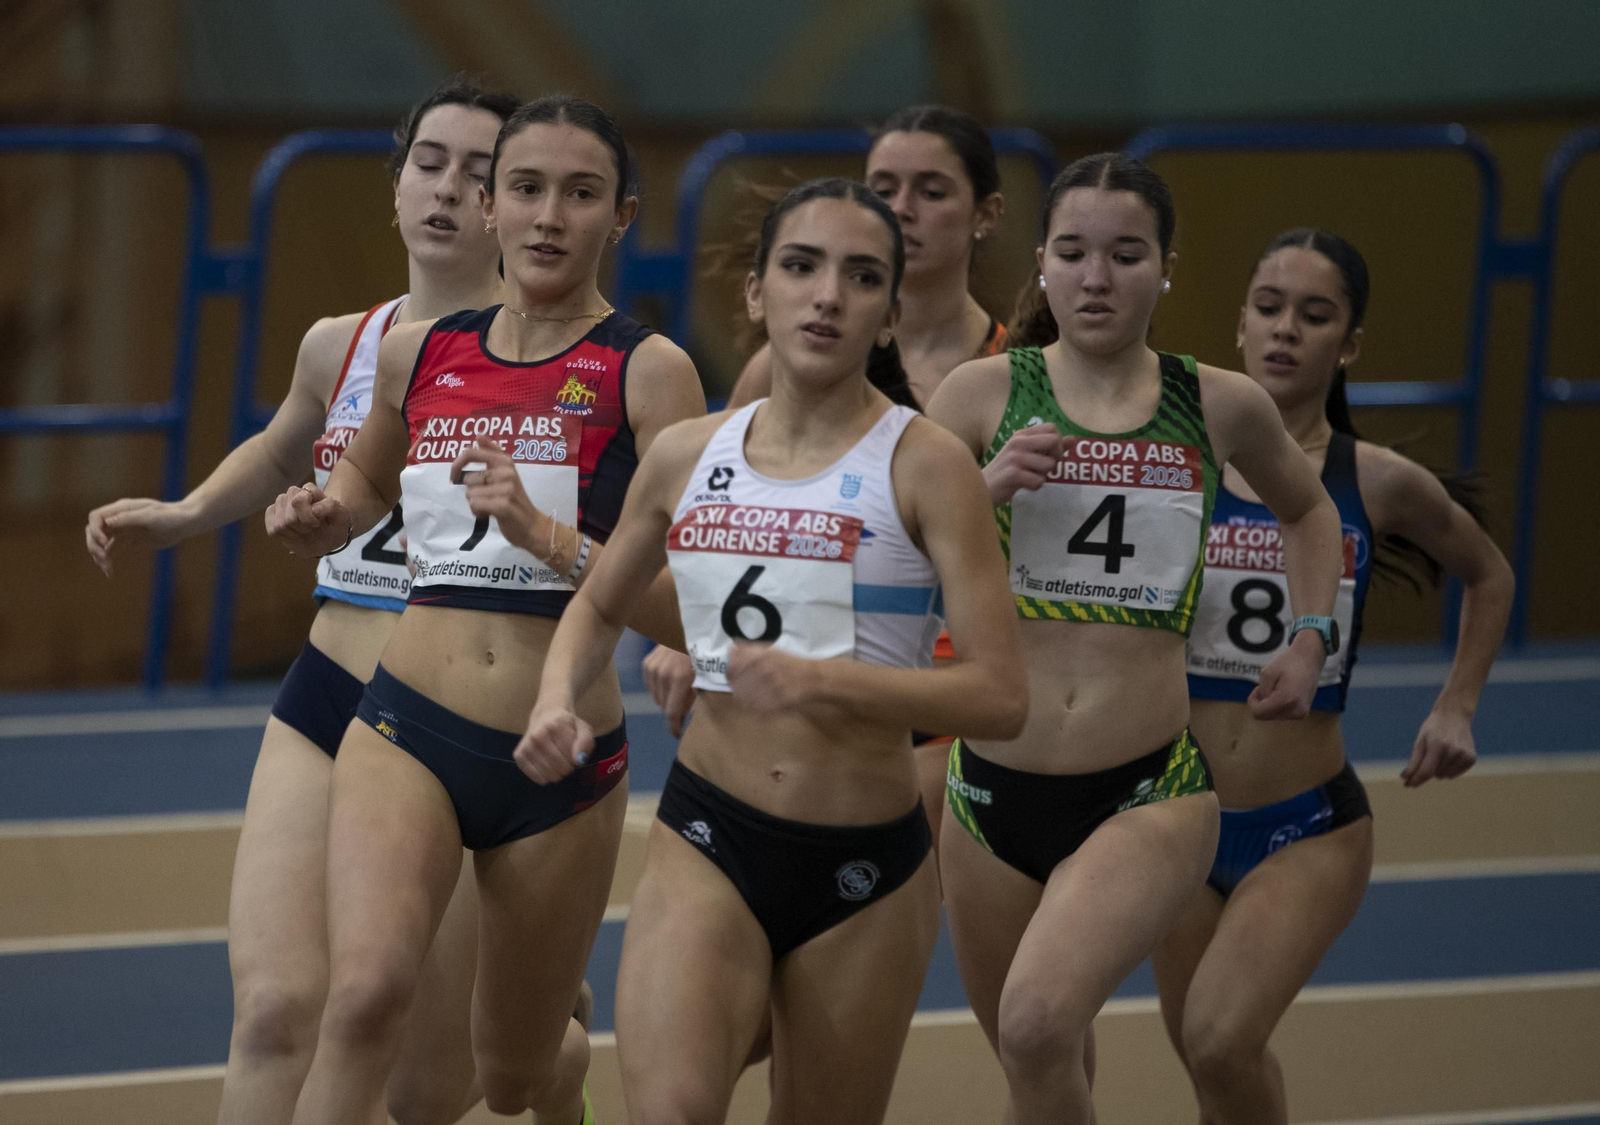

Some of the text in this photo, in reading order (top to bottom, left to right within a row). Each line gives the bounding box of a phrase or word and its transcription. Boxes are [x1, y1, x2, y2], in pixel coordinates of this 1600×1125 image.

[566, 361, 607, 372] OURENSE
[577, 358, 601, 367] CLUB
[552, 405, 593, 416] ATLETISMO
[423, 415, 562, 438] XXI COPA ABS
[511, 438, 568, 462] 2026
[1075, 440, 1140, 463] COPA
[1143, 442, 1187, 465] ABS
[1046, 460, 1194, 489] URENSE 2026
[693, 506, 845, 536] XXI COPA ABS
[678, 525, 845, 559] OURENSE 2026
[1067, 494, 1136, 575] 4
[1207, 524, 1230, 546] XI
[428, 559, 517, 583] atletismo.gal
[1204, 546, 1286, 571] URENSE
[342, 568, 413, 595] atletismo.g
[1044, 578, 1144, 603] atletismo.gal
[720, 565, 783, 642] 6
[1227, 578, 1286, 655] 8
[1205, 655, 1262, 676] atletism
